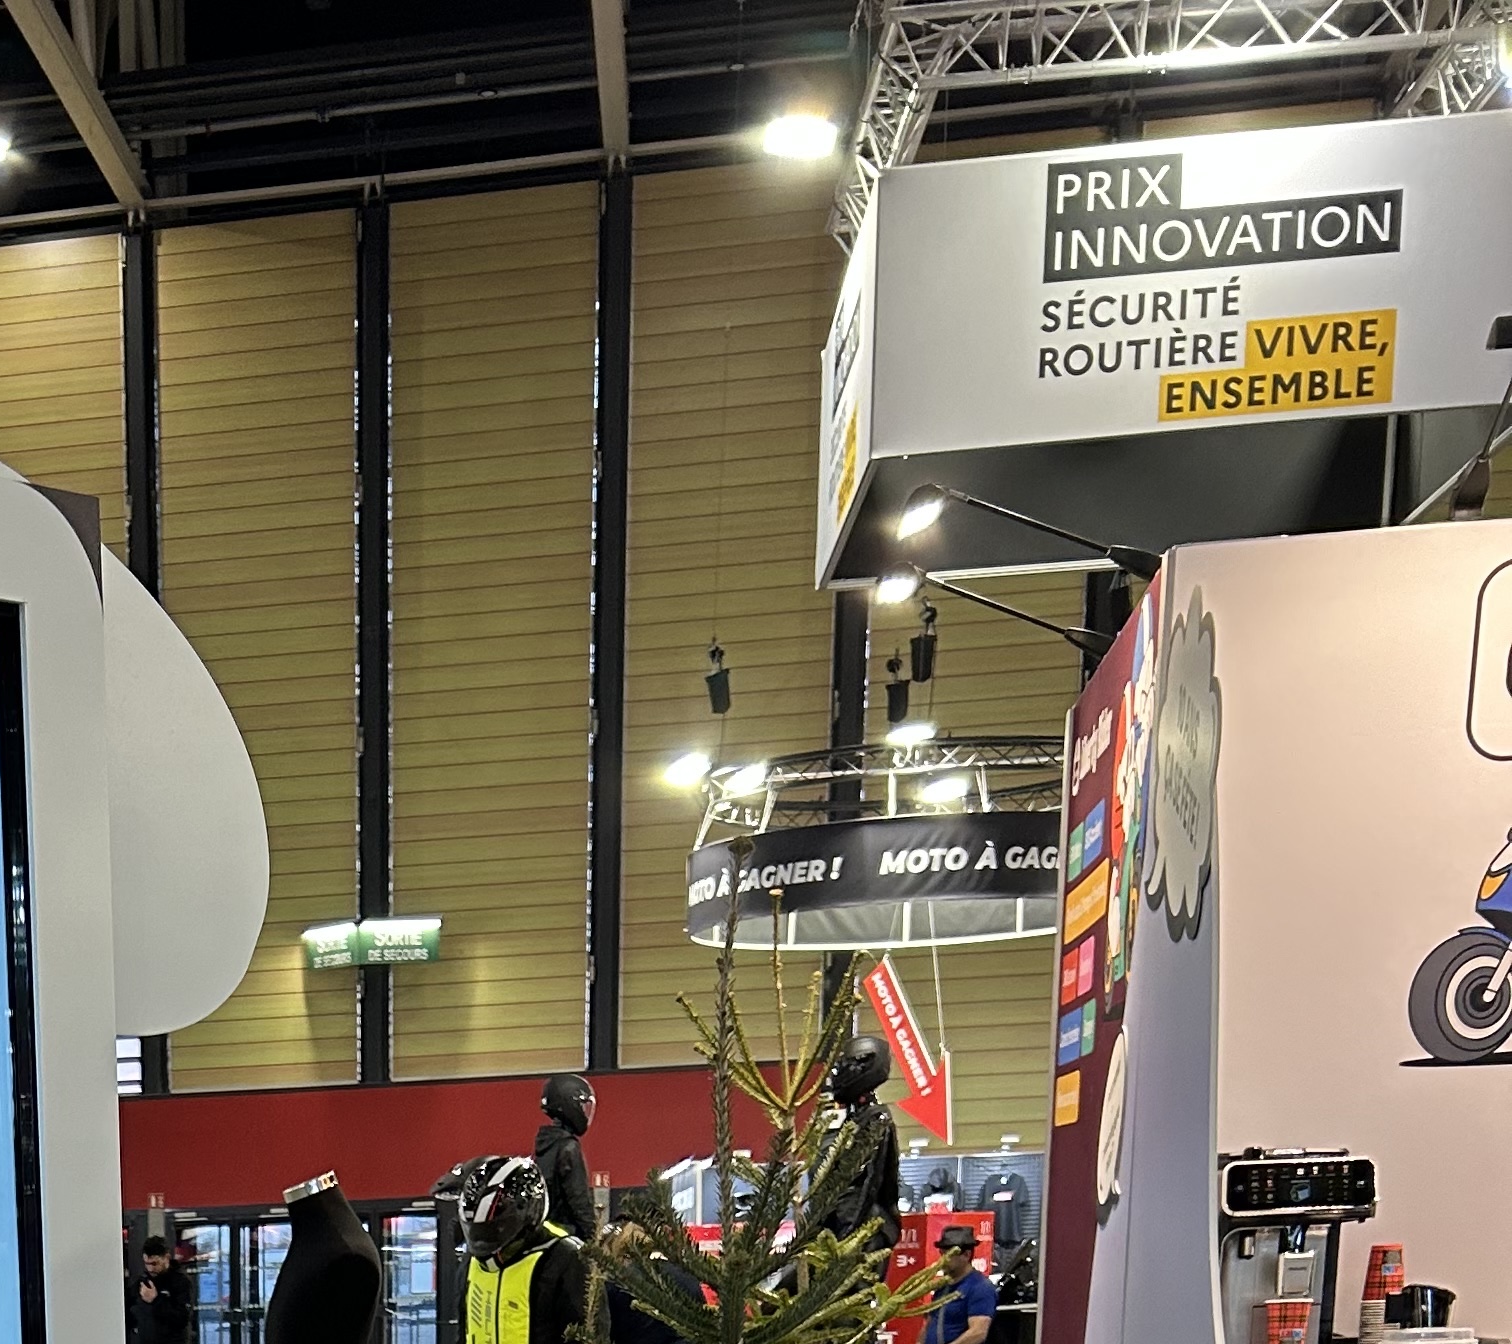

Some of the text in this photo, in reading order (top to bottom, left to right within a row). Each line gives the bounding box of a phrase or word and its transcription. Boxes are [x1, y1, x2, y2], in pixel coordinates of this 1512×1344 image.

[1055, 164, 1170, 214] PRIX
[1052, 201, 1392, 272] INNOVATION
[1040, 275, 1243, 334] SÉCURITÉ
[1037, 317, 1389, 379] ROUTIÈRE VIVRE,
[1165, 365, 1376, 414] ENSEMBLE
[878, 847, 970, 875] MOTO
[974, 841, 998, 870] À
[1004, 846, 1059, 870] GAG
